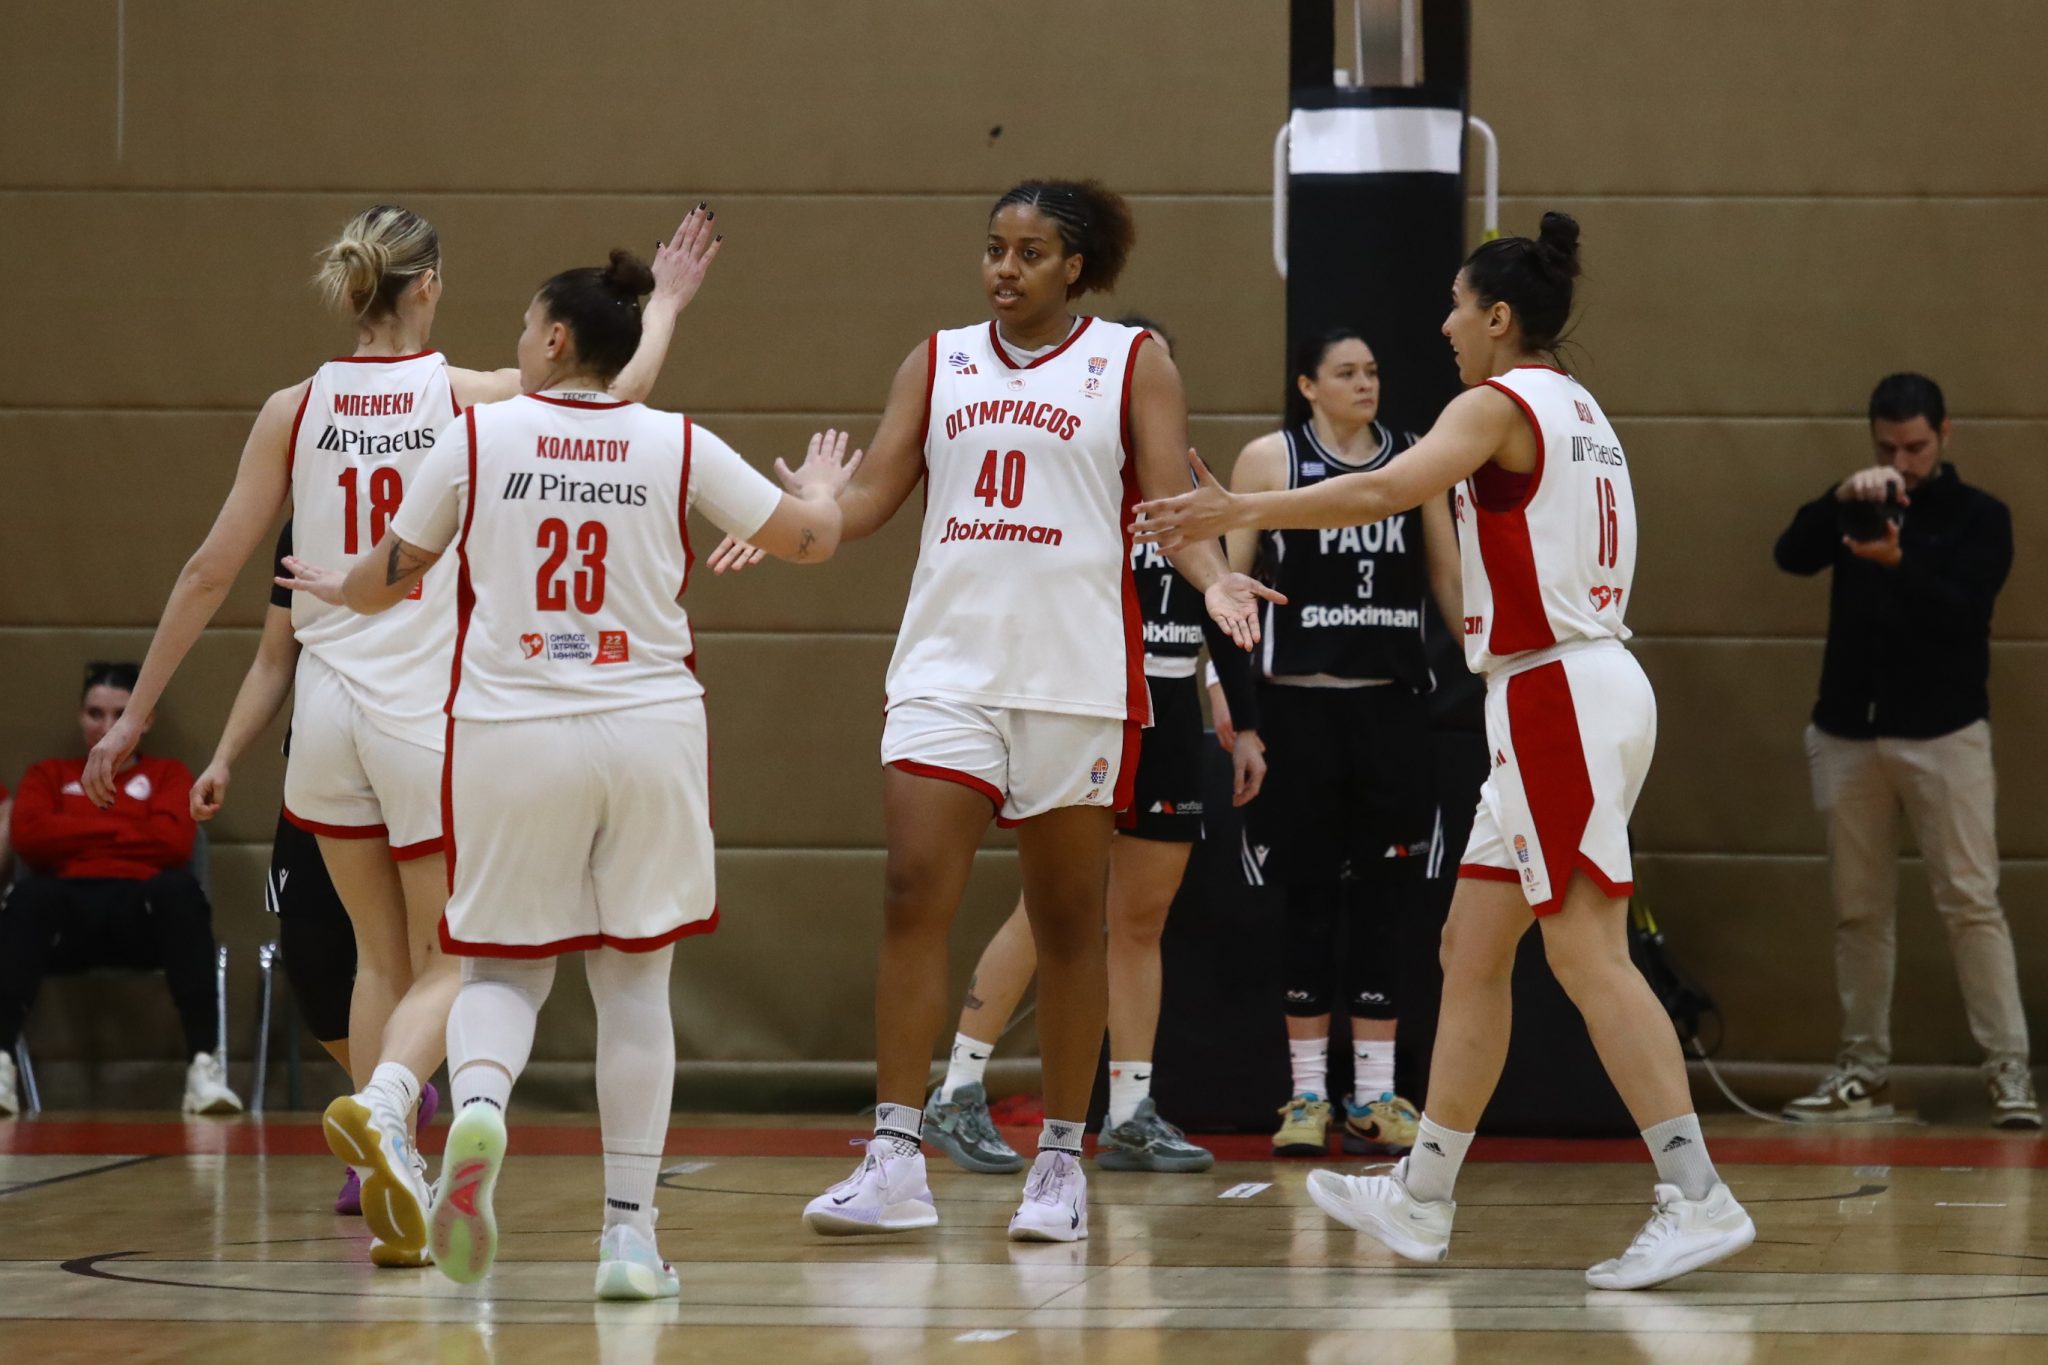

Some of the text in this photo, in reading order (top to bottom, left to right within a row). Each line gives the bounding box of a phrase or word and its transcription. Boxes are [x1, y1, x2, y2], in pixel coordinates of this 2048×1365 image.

[334, 391, 414, 417] ΜΠΕΝΕΚΗ
[945, 399, 1082, 441] OLYMPIACOS
[340, 427, 436, 455] Piraeus
[536, 435, 630, 463] ΚΟΛΛΑΤΟΥ
[539, 473, 648, 507] Piraeus
[974, 449, 1026, 509] 40
[338, 466, 401, 555] 18
[1596, 476, 1618, 569] 16
[940, 516, 1063, 546] Stoiximan
[1319, 515, 1406, 555] PAOK
[536, 517, 608, 615] 23
[1357, 559, 1374, 599] 3
[1160, 573, 1173, 615] 7
[1301, 603, 1419, 629] Stoiximan
